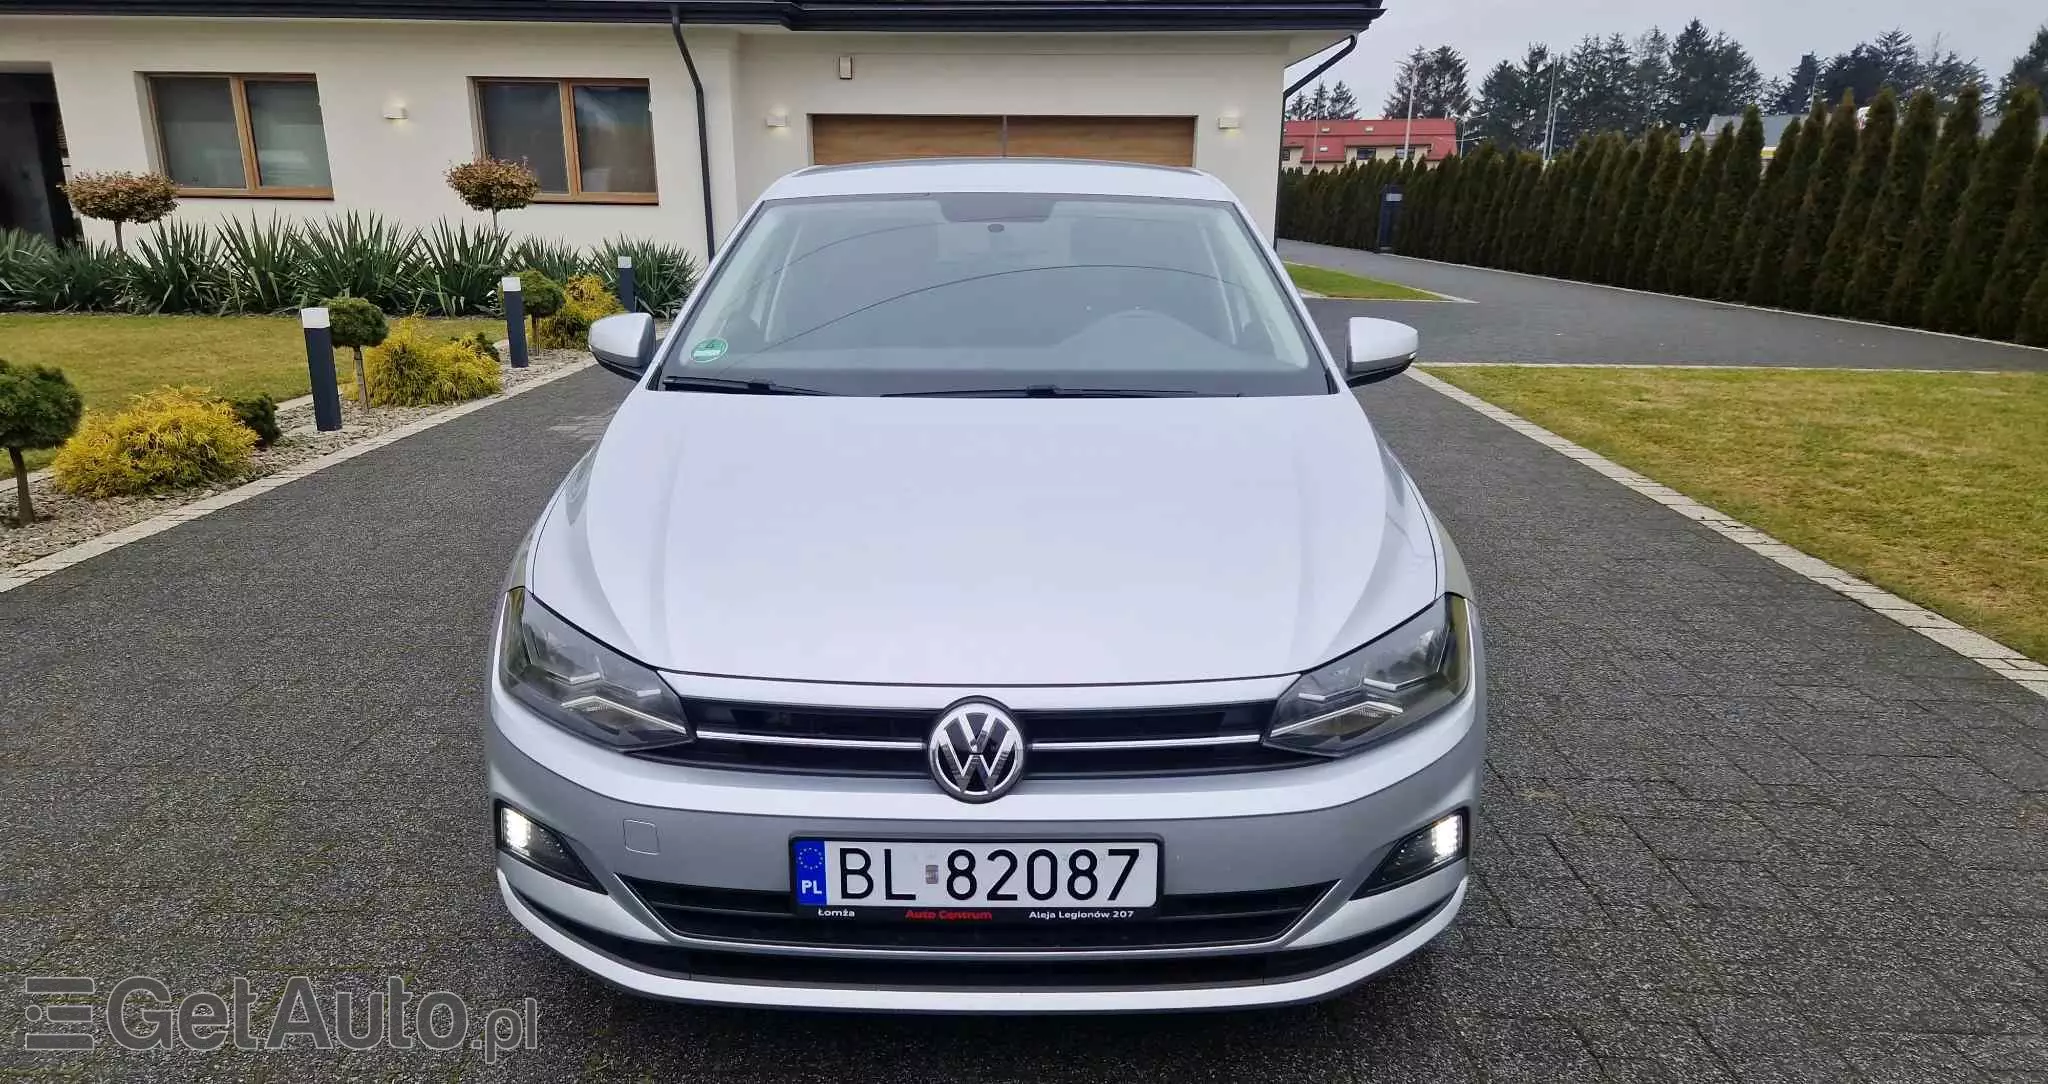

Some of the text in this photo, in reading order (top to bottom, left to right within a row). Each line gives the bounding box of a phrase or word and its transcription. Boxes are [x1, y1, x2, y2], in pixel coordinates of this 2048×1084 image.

[839, 847, 1141, 902] BL 82087
[801, 879, 823, 895] PL
[817, 908, 856, 918] Łomża
[905, 909, 993, 921] Auto Centrum
[1029, 910, 1135, 921] Aleja Legionów 207
